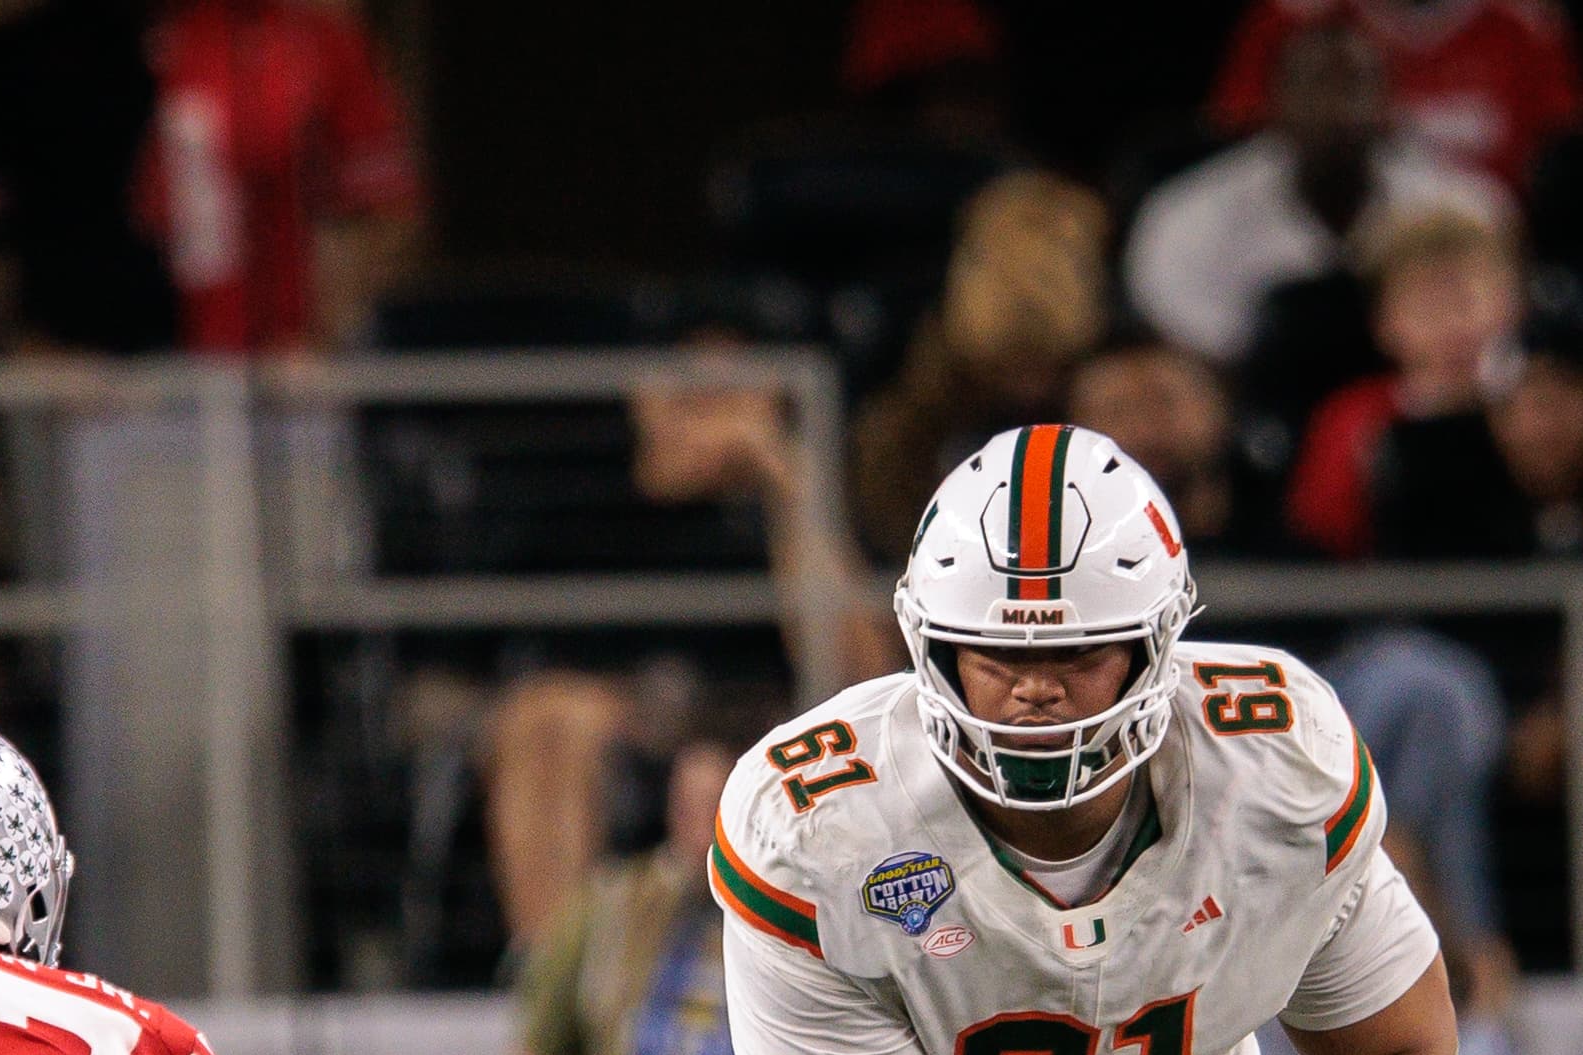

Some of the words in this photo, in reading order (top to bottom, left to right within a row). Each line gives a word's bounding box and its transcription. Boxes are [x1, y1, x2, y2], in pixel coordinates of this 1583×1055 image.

[1002, 609, 1064, 624] MIAMI
[1193, 660, 1294, 736] 61
[766, 719, 878, 814] 61
[869, 868, 949, 908] COTTON
[887, 887, 937, 911] BOWL
[1063, 918, 1106, 949] U
